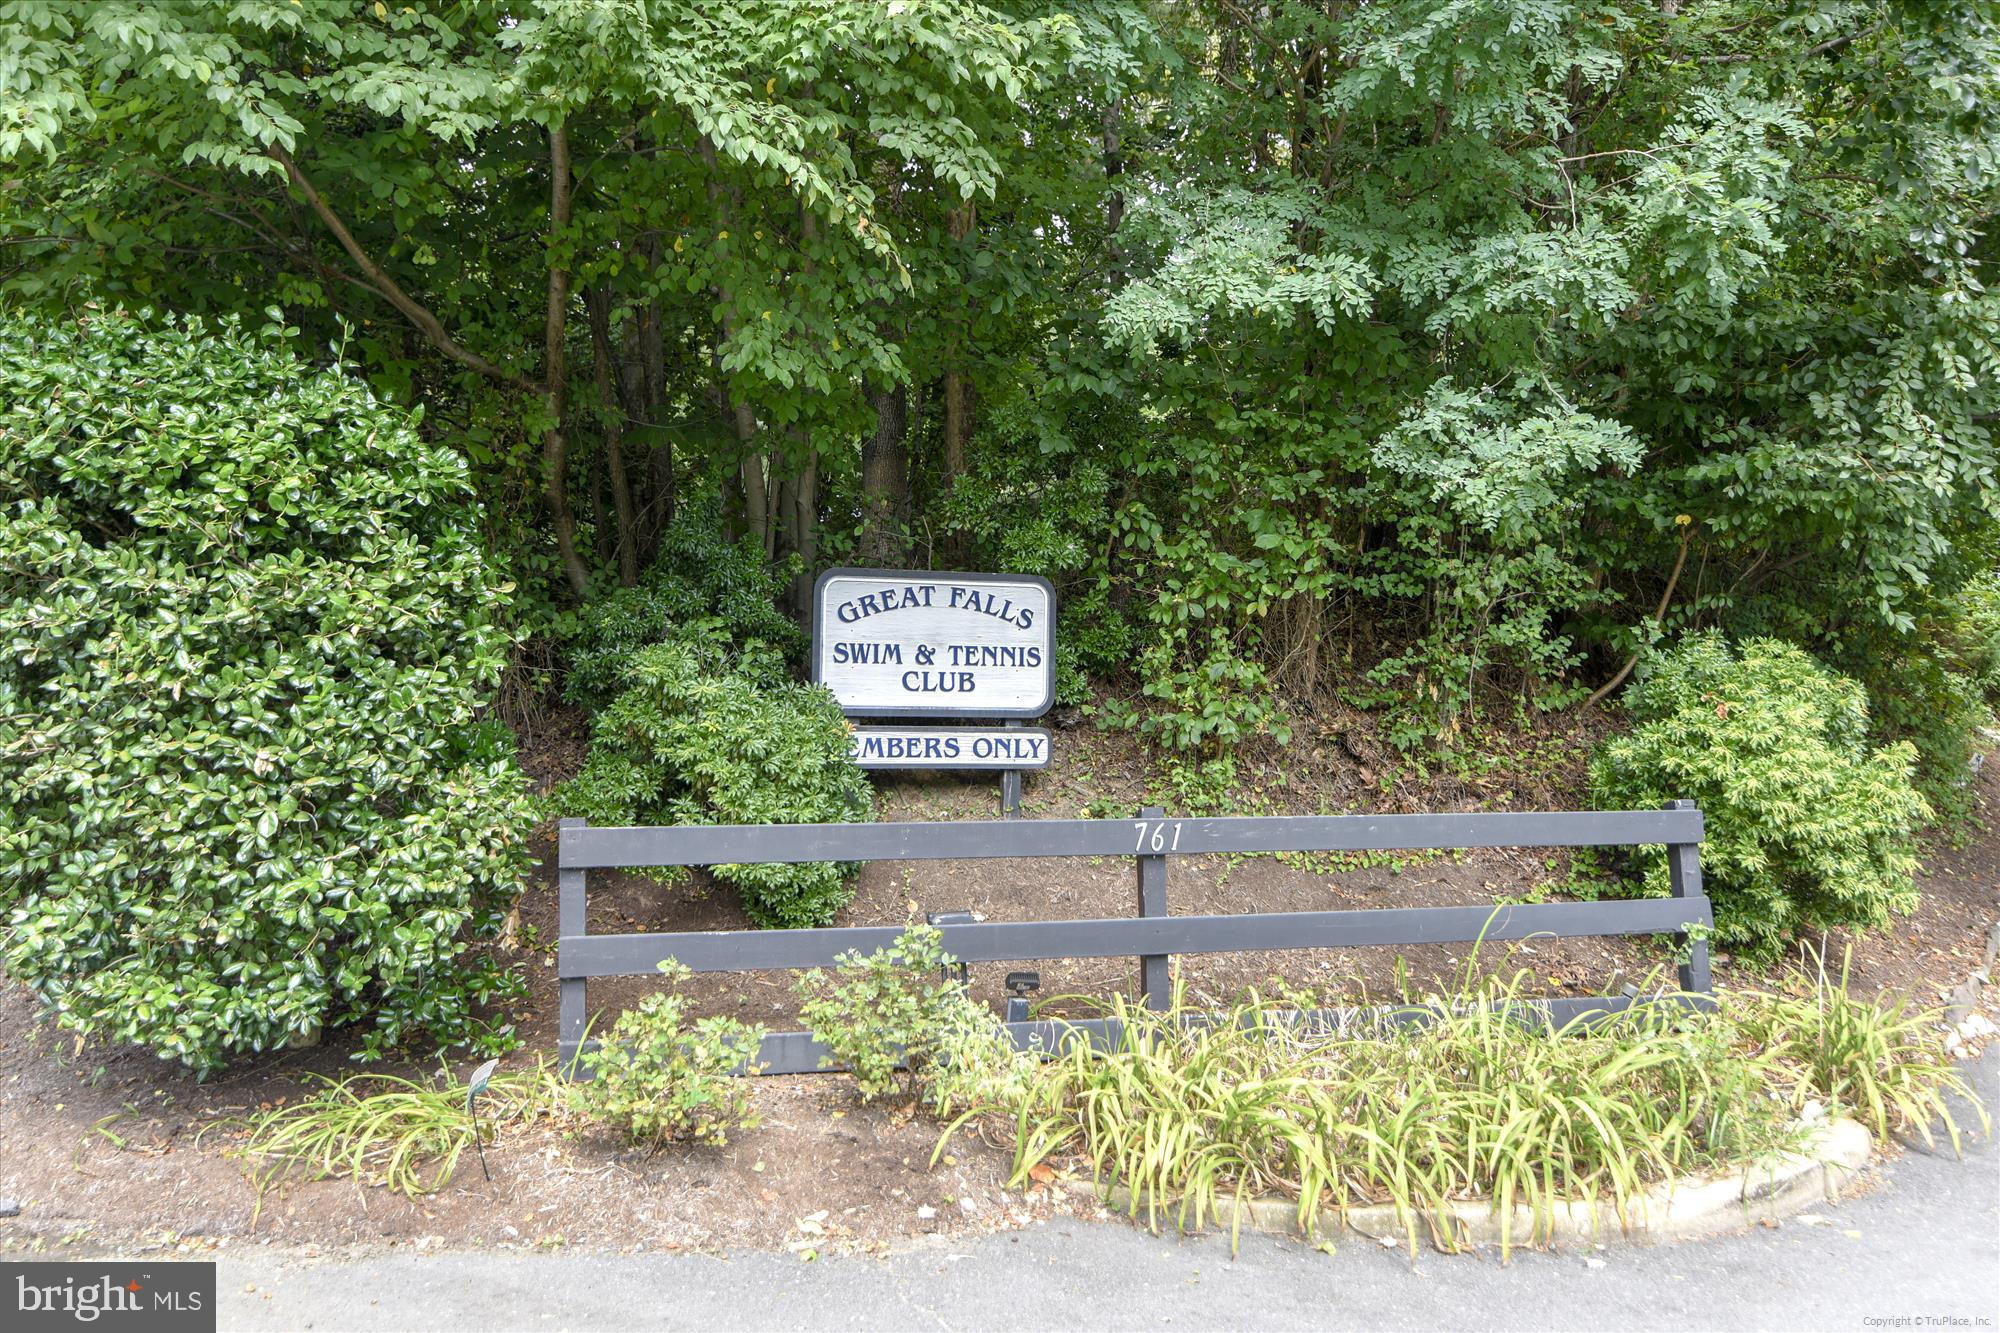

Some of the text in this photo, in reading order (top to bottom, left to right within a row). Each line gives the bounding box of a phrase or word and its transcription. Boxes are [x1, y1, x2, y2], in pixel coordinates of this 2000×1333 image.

[837, 585, 1034, 630] GREAT FALLS
[833, 642, 1042, 667] SWIM & TENNIS
[902, 671, 976, 692] CLUB
[972, 737, 1045, 759] ONLY
[1134, 822, 1182, 852] 761
